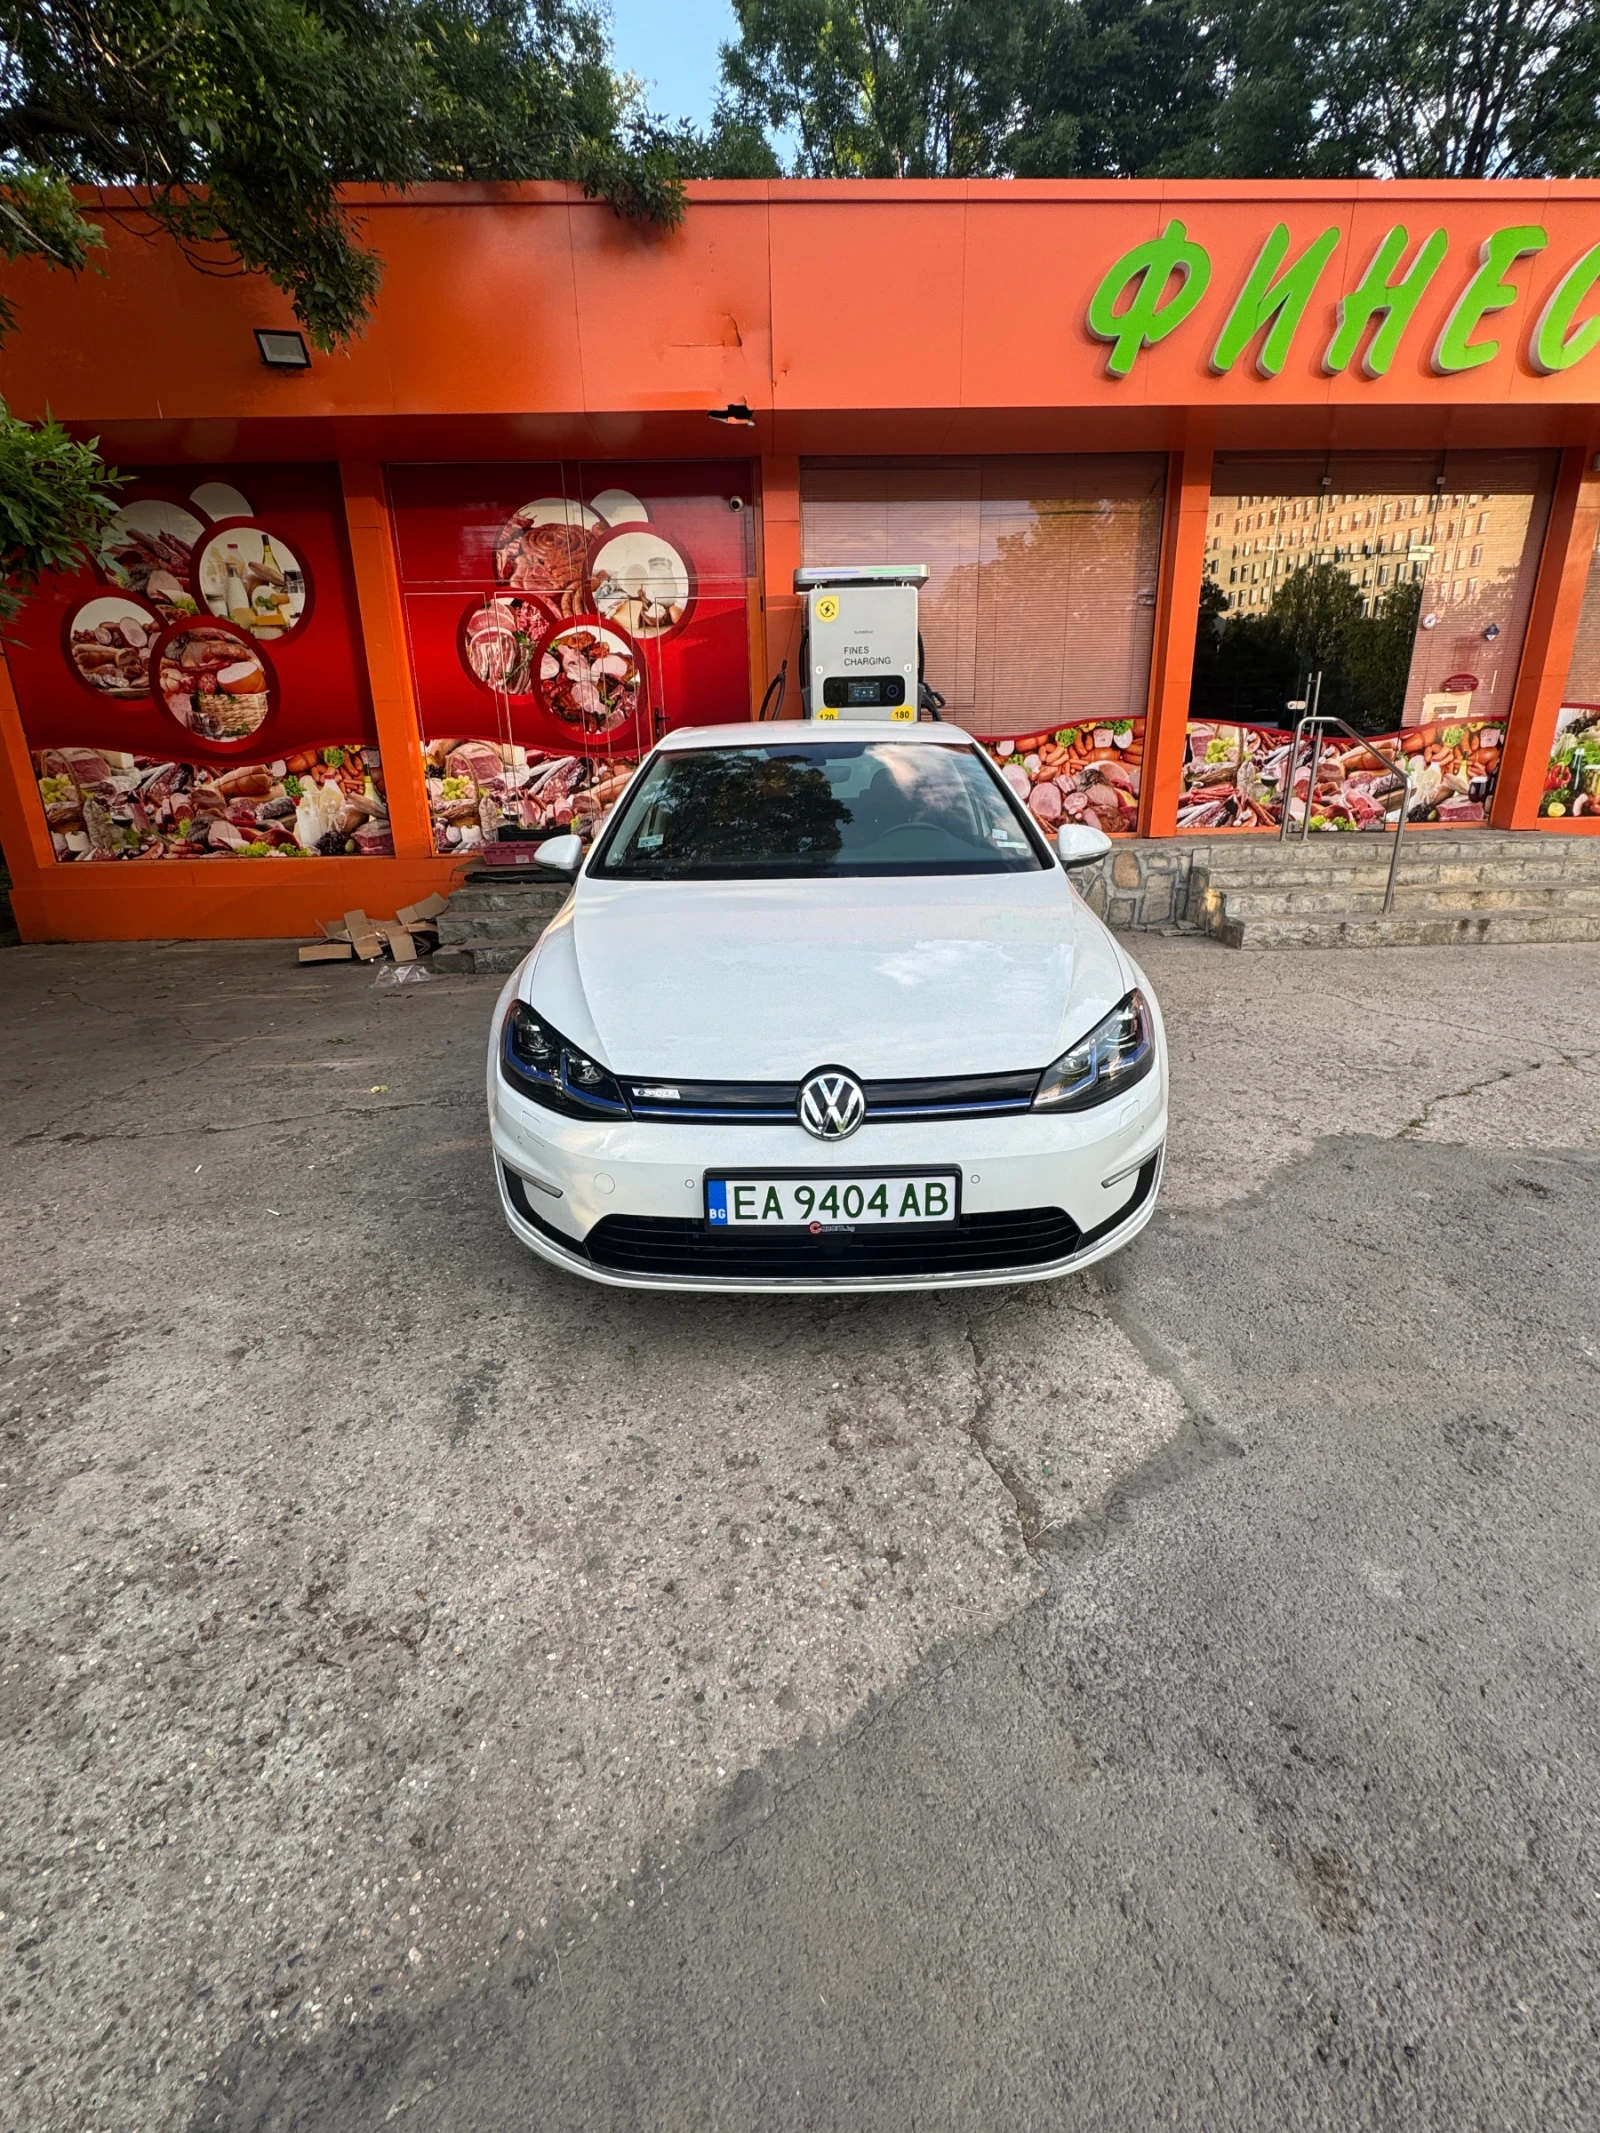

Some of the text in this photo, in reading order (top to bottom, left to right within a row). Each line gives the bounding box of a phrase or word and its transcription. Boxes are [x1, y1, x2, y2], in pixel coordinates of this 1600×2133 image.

[843, 646, 869, 655] FINES
[843, 656, 891, 666] CHARGING
[894, 710, 910, 719] 180
[733, 1182, 949, 1220] EA 9404 AB
[709, 1208, 727, 1220] BG
